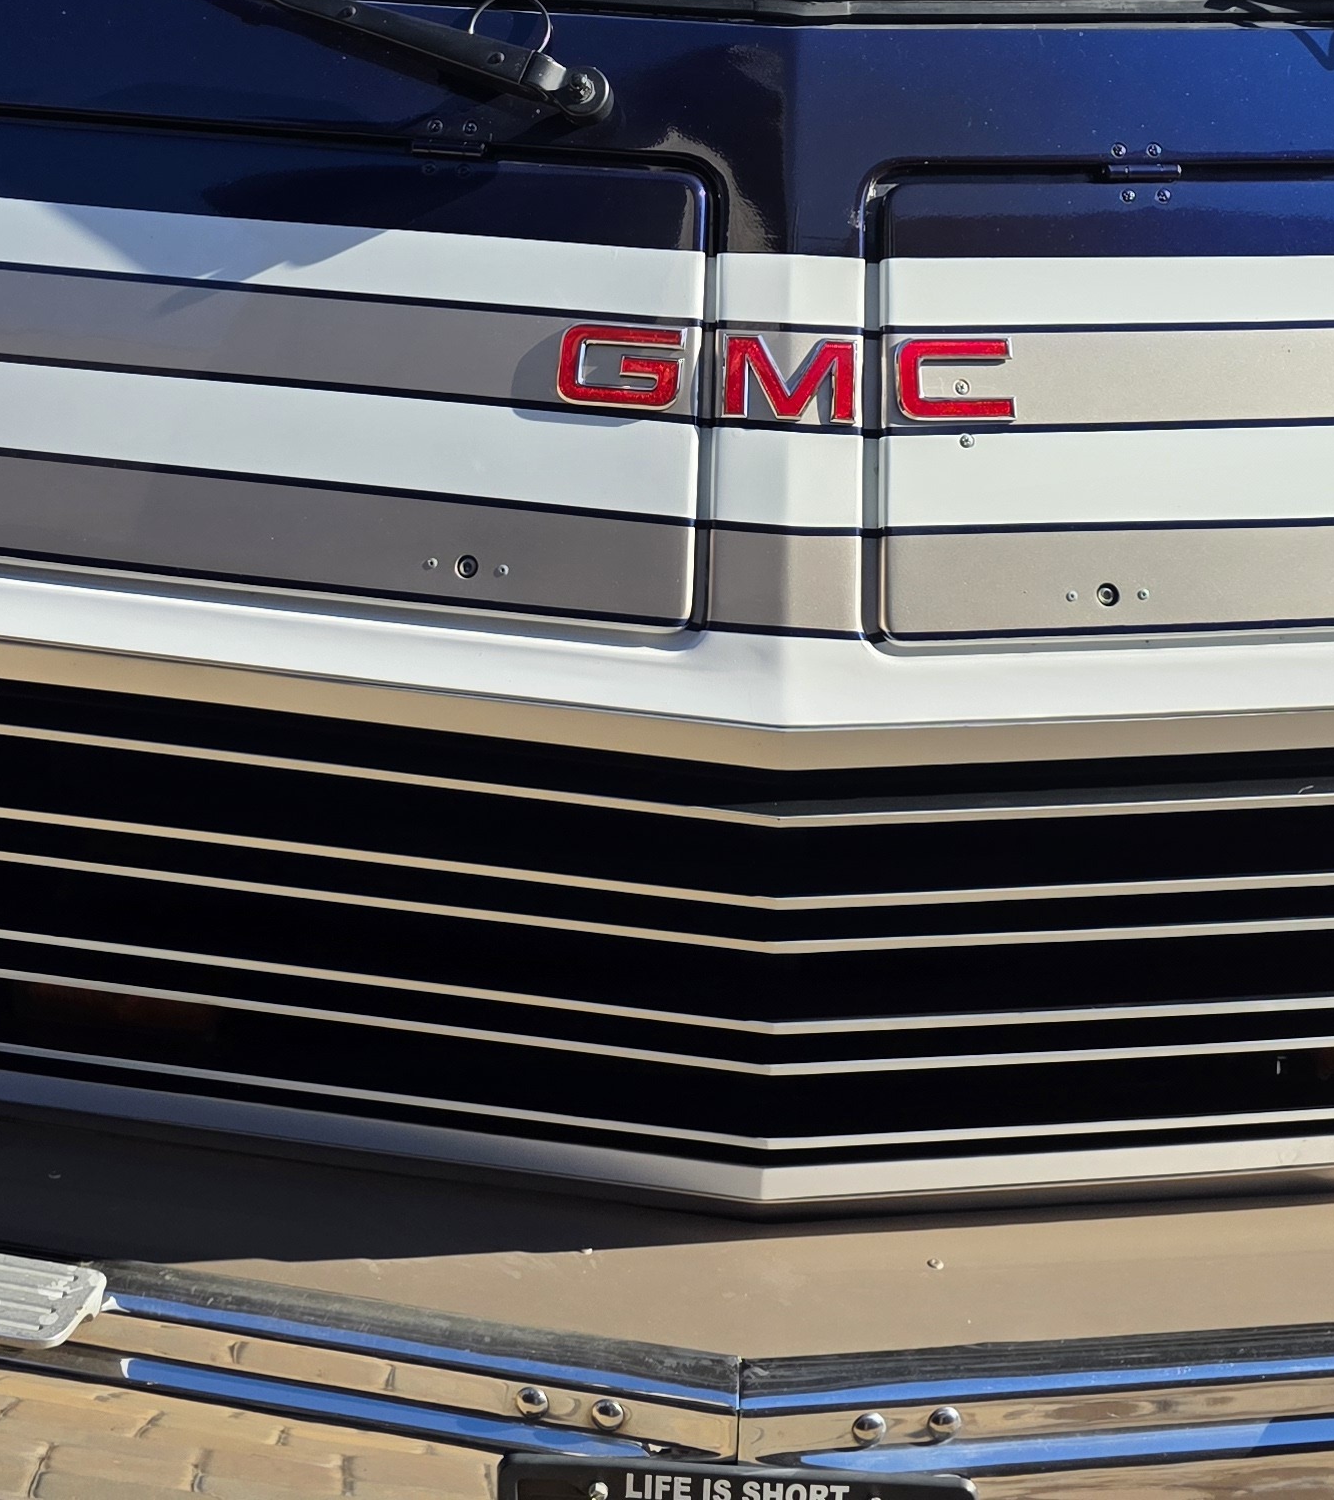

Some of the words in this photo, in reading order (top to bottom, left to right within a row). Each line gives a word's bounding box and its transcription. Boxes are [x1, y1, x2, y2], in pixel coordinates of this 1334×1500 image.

[556, 322, 1018, 425] GMC
[625, 1472, 692, 1500] LIFE
[702, 1478, 732, 1500] IS
[741, 1480, 850, 1500] SHORT
